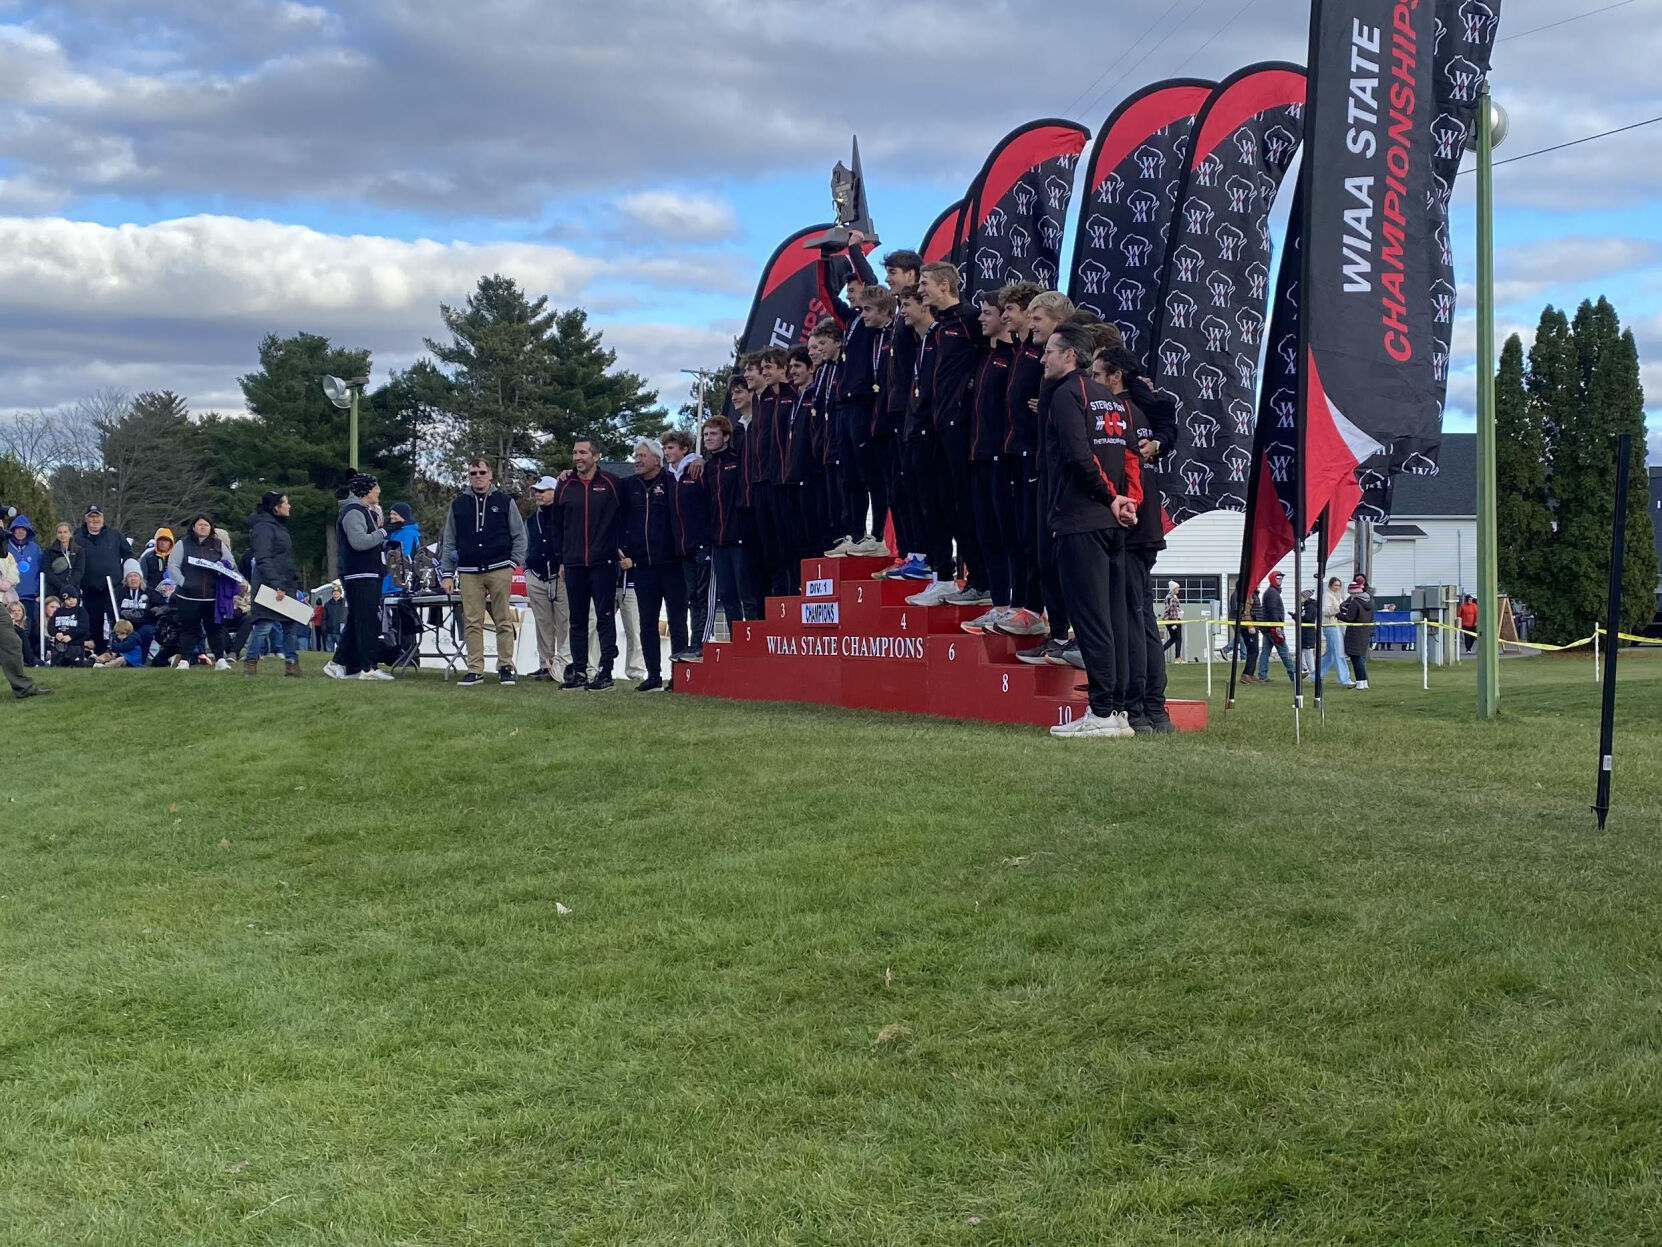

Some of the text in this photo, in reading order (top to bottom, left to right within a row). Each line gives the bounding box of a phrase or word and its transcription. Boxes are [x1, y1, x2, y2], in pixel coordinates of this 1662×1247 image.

[1343, 17, 1381, 293] WIAA STATE
[810, 582, 827, 594] DIV. 1
[857, 586, 863, 603] 2
[780, 602, 786, 618] 3
[805, 604, 835, 623] CHAMPIONS
[900, 612, 907, 630] 4
[746, 626, 751, 641] 5
[715, 648, 721, 662] 7
[766, 635, 924, 659] WIAA STATE CHAMPIONS
[948, 642, 955, 661] 6
[685, 668, 691, 682] 9
[1002, 673, 1009, 693] 8
[1058, 705, 1073, 726] 10
